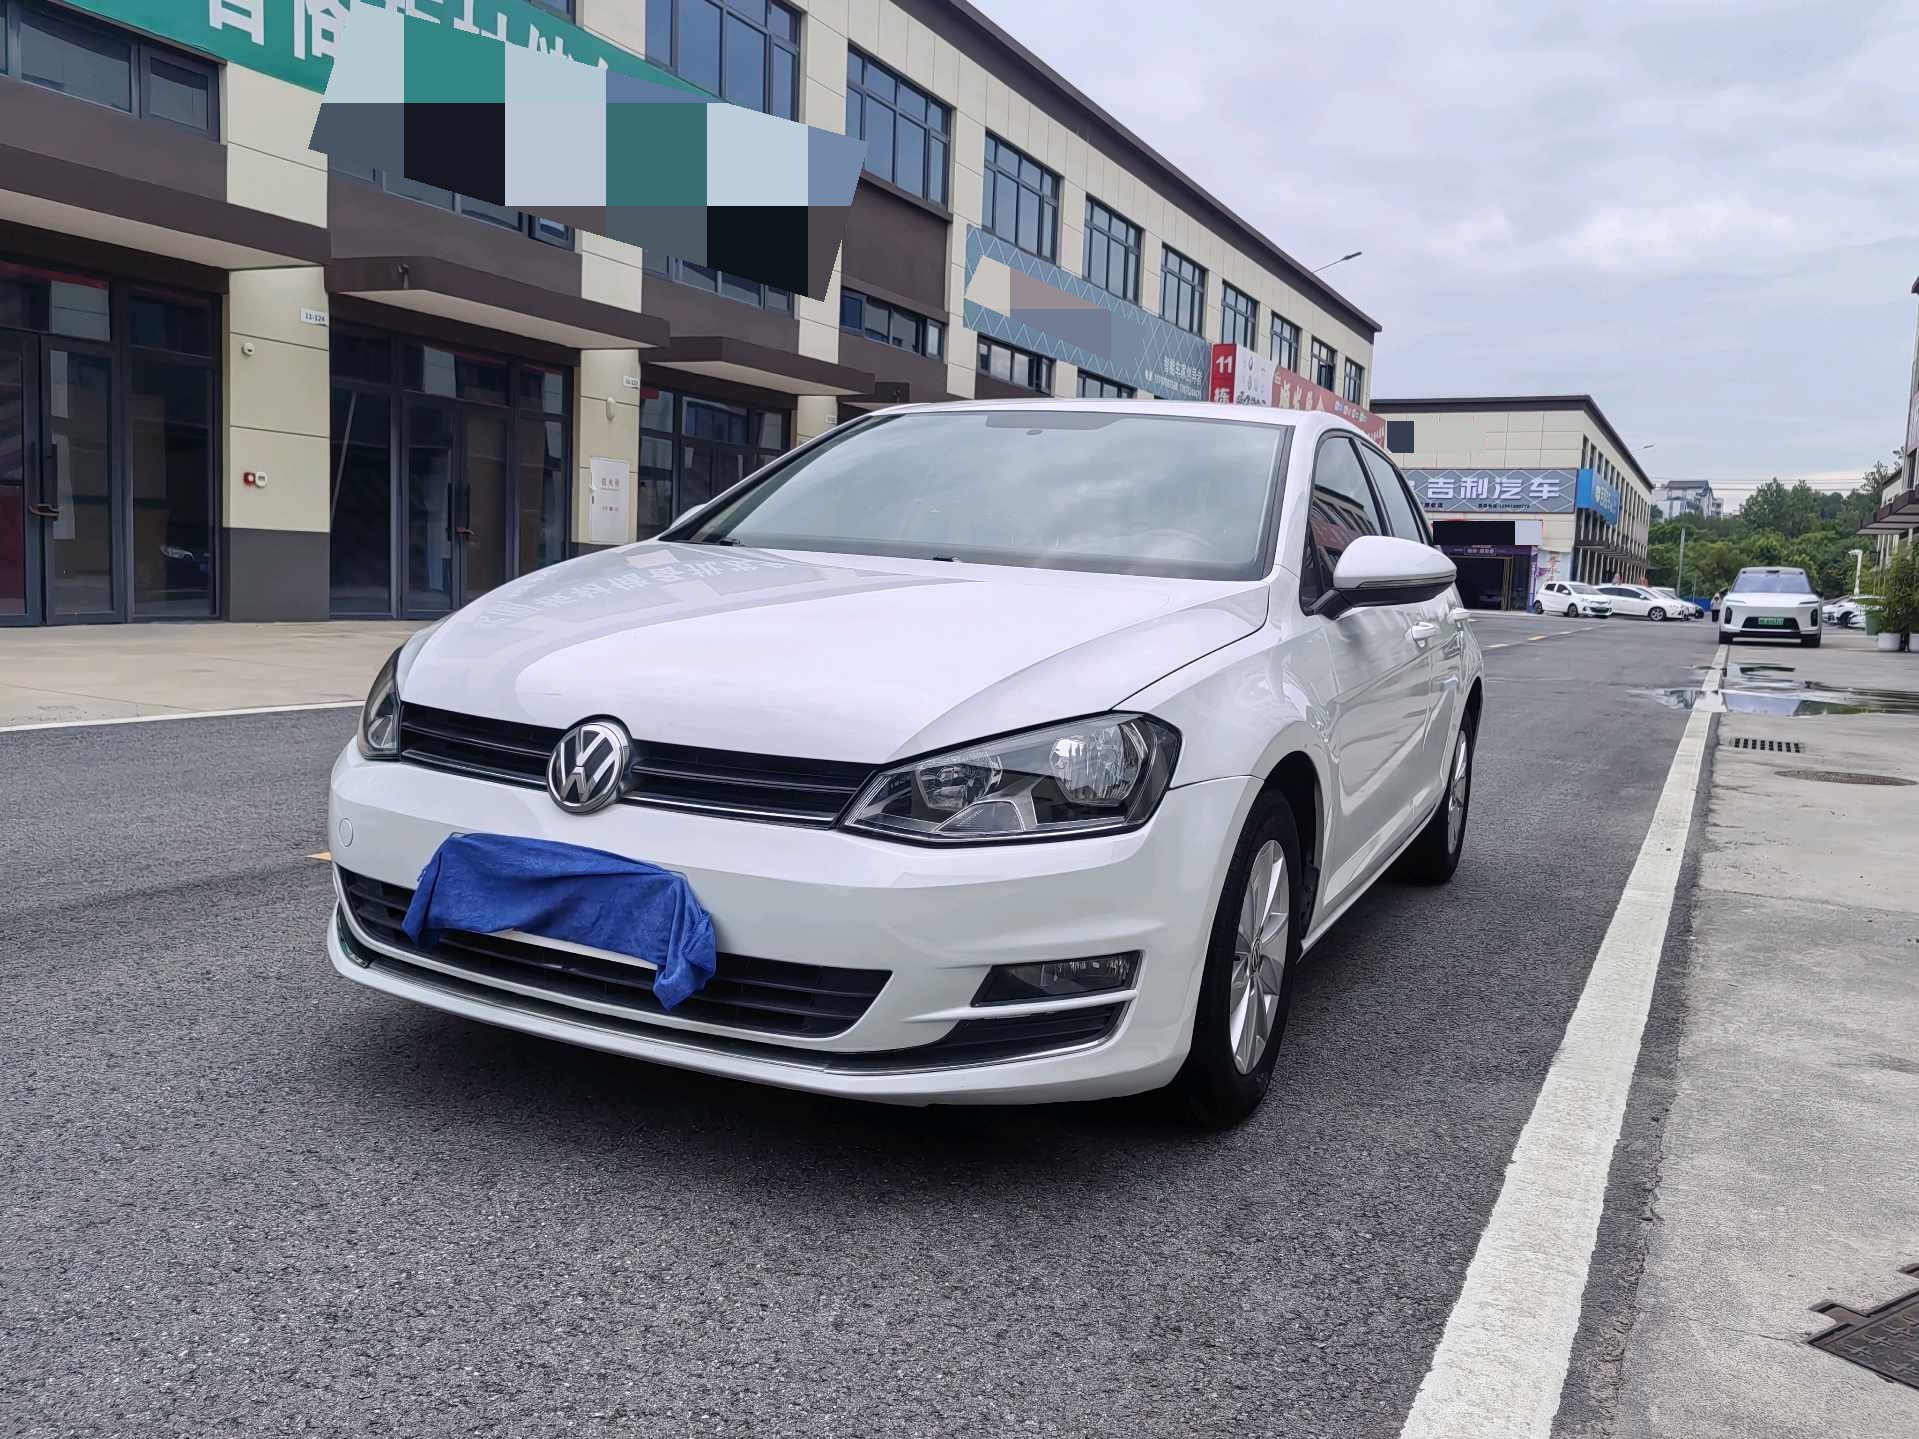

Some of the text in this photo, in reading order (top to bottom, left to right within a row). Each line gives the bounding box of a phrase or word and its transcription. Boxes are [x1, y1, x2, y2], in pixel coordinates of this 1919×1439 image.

[1216, 355, 1233, 374] 11
[1427, 478, 1560, 500] 吉利汽车
